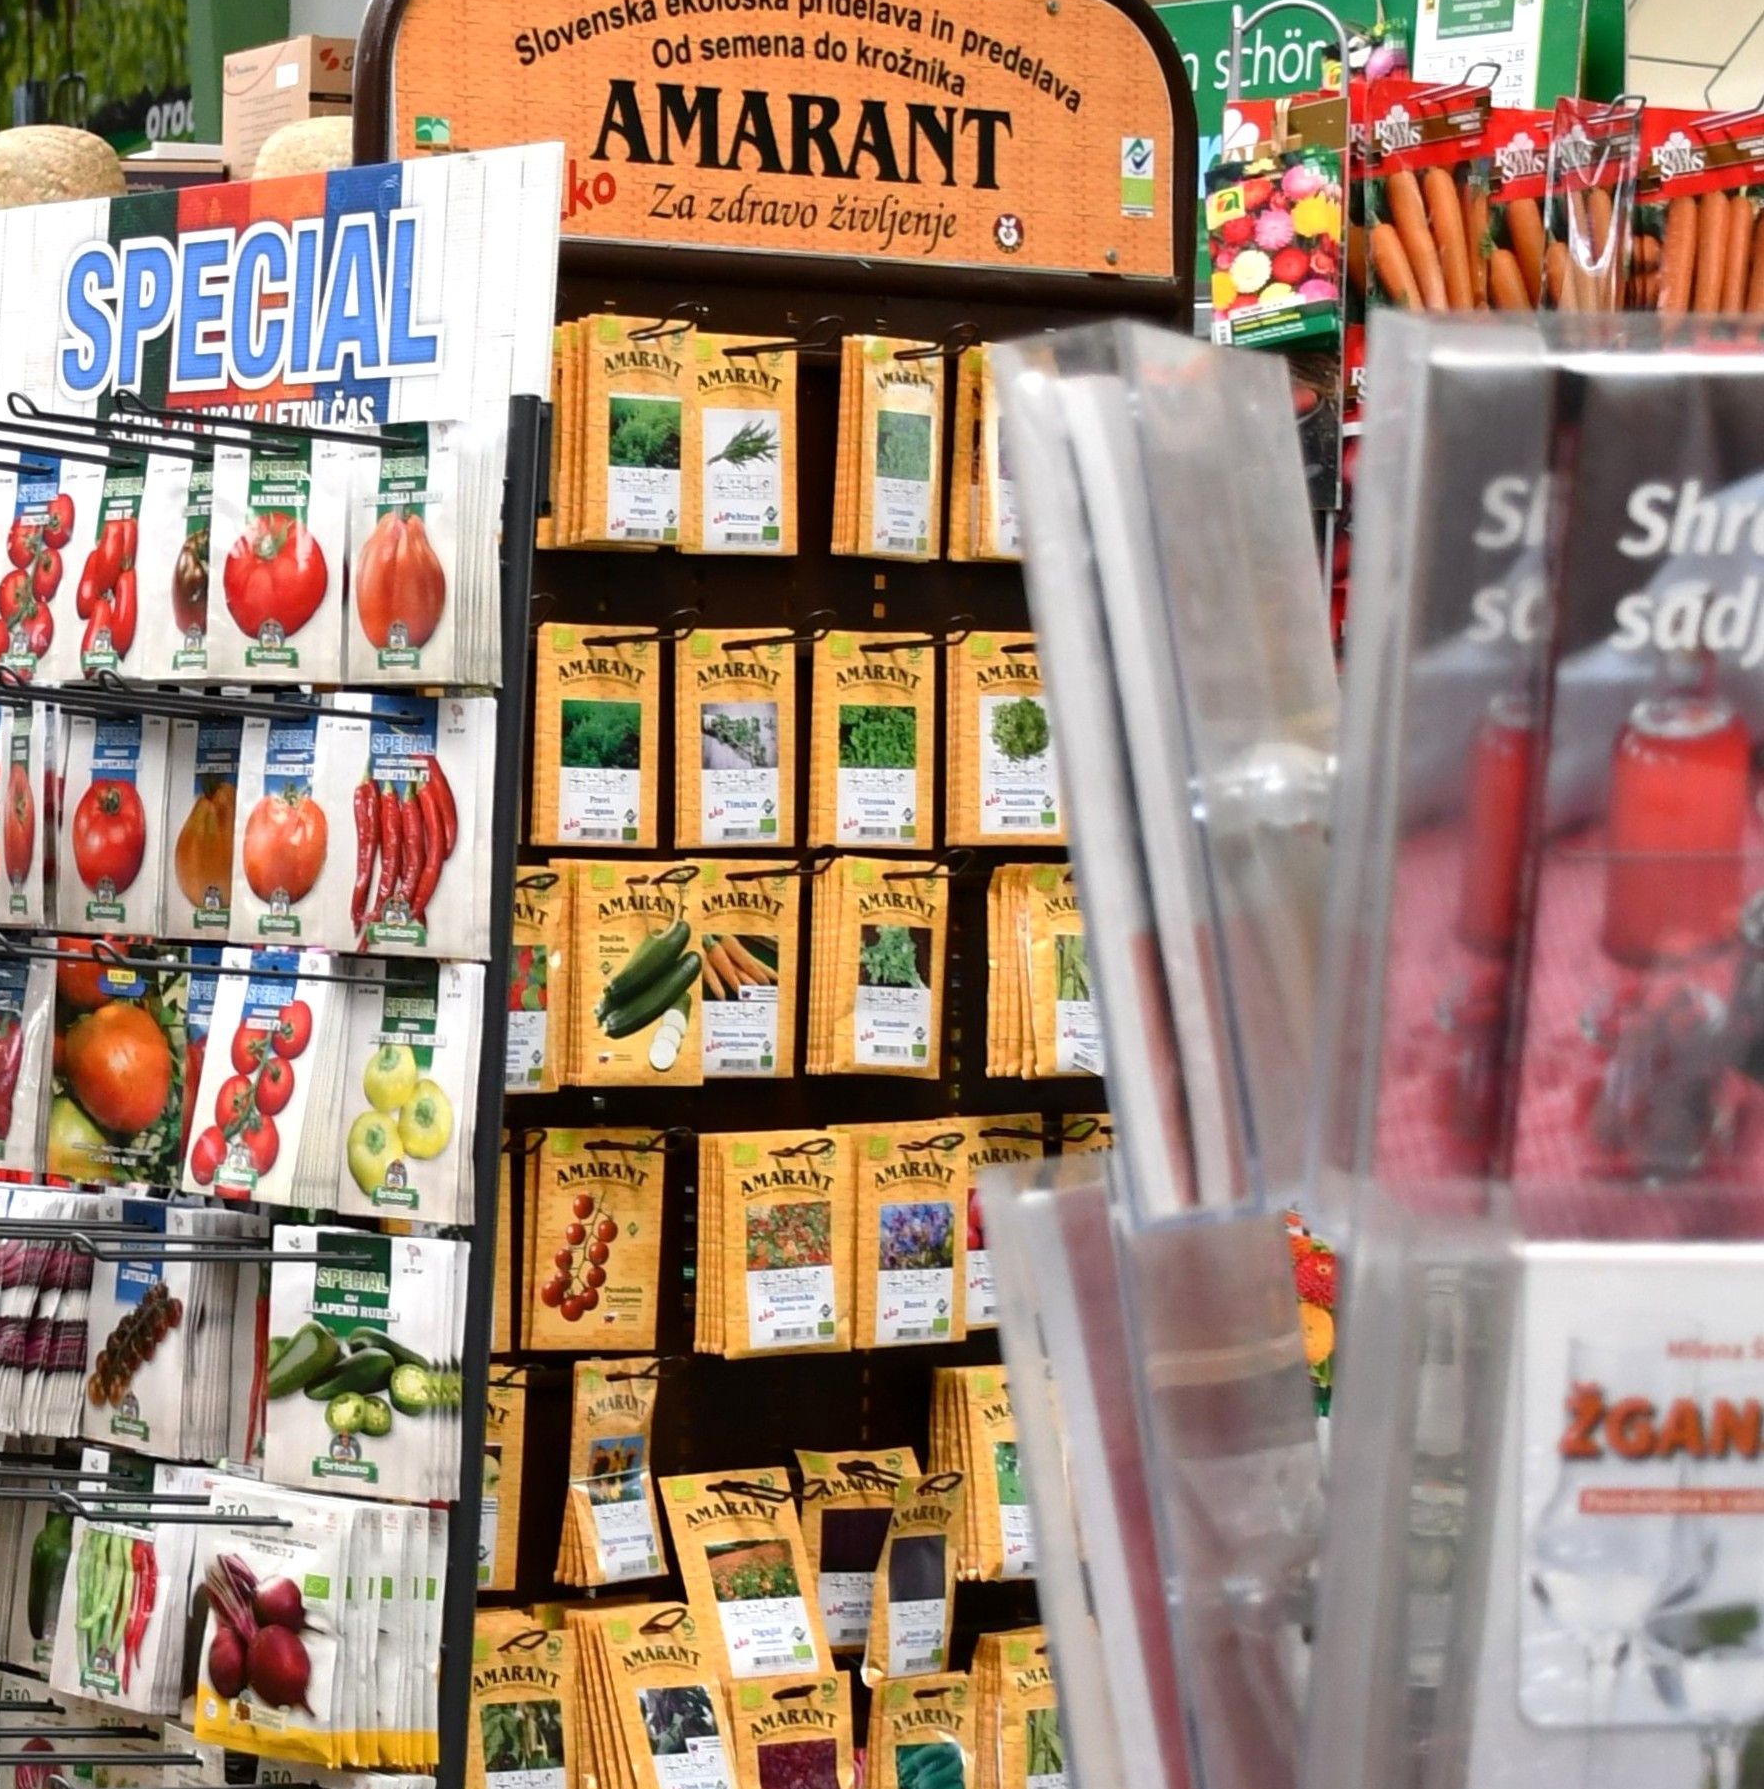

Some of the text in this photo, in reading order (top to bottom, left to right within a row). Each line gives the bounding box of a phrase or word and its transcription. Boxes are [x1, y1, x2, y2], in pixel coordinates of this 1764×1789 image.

[652, 30, 966, 98] Od semena do krožnika
[932, 10, 955, 41] in
[962, 27, 1083, 115] predelava
[591, 78, 1011, 192] AMARANT
[560, 159, 617, 222] ko
[647, 182, 958, 257] Za zdravo življenje
[57, 205, 444, 403] SPECIAL
[604, 350, 683, 378] AMARANT
[697, 368, 783, 393] AMARANT
[330, 390, 375, 426] ČAS
[558, 658, 646, 685] AMARANT
[696, 662, 782, 687] AMARANT
[836, 664, 922, 690] AMARANT
[371, 733, 435, 755] SPECIAL
[597, 895, 689, 921] AMARANT
[701, 891, 785, 917] AMARANT
[858, 892, 937, 919] AMARANT
[556, 1161, 649, 1188] AMARANT
[740, 1167, 835, 1198] AMARANT
[873, 1161, 956, 1189] AMARANT
[316, 1267, 389, 1293] SPECIAL
[685, 1501, 780, 1529] AMARANT
[620, 1645, 702, 1672] AMARANT
[473, 1665, 561, 1693] AMARANT
[749, 1708, 839, 1739] AMARANT
[892, 1707, 965, 1736] AMARANT
